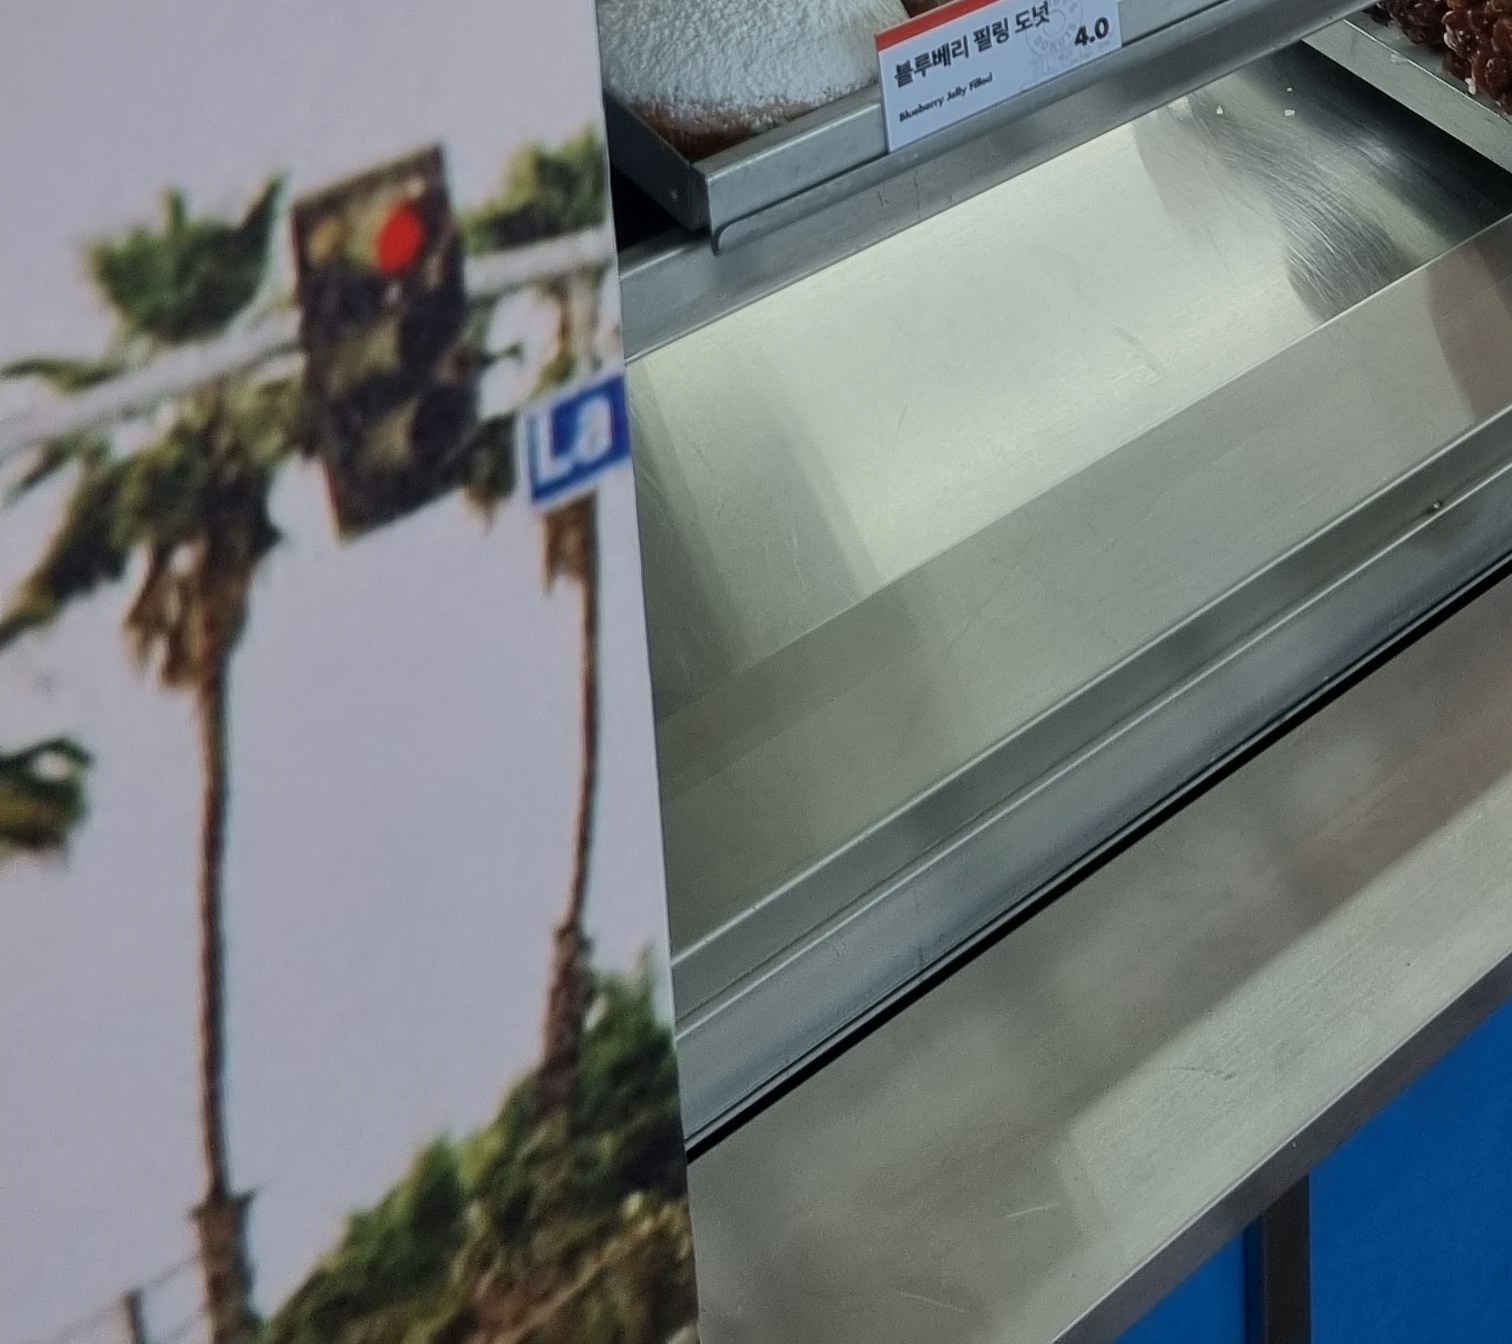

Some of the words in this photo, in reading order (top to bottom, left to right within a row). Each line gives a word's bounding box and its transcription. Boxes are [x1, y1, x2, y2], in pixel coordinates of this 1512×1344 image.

[894, 34, 970, 88] 블루베리
[973, 17, 1010, 53] 필링
[1014, 0, 1051, 34] 도넛
[1074, 16, 1110, 48] 4.0
[898, 95, 945, 123] Blueberry
[946, 84, 968, 103] Jelly
[969, 71, 993, 92] Filled
[535, 395, 614, 485] La
